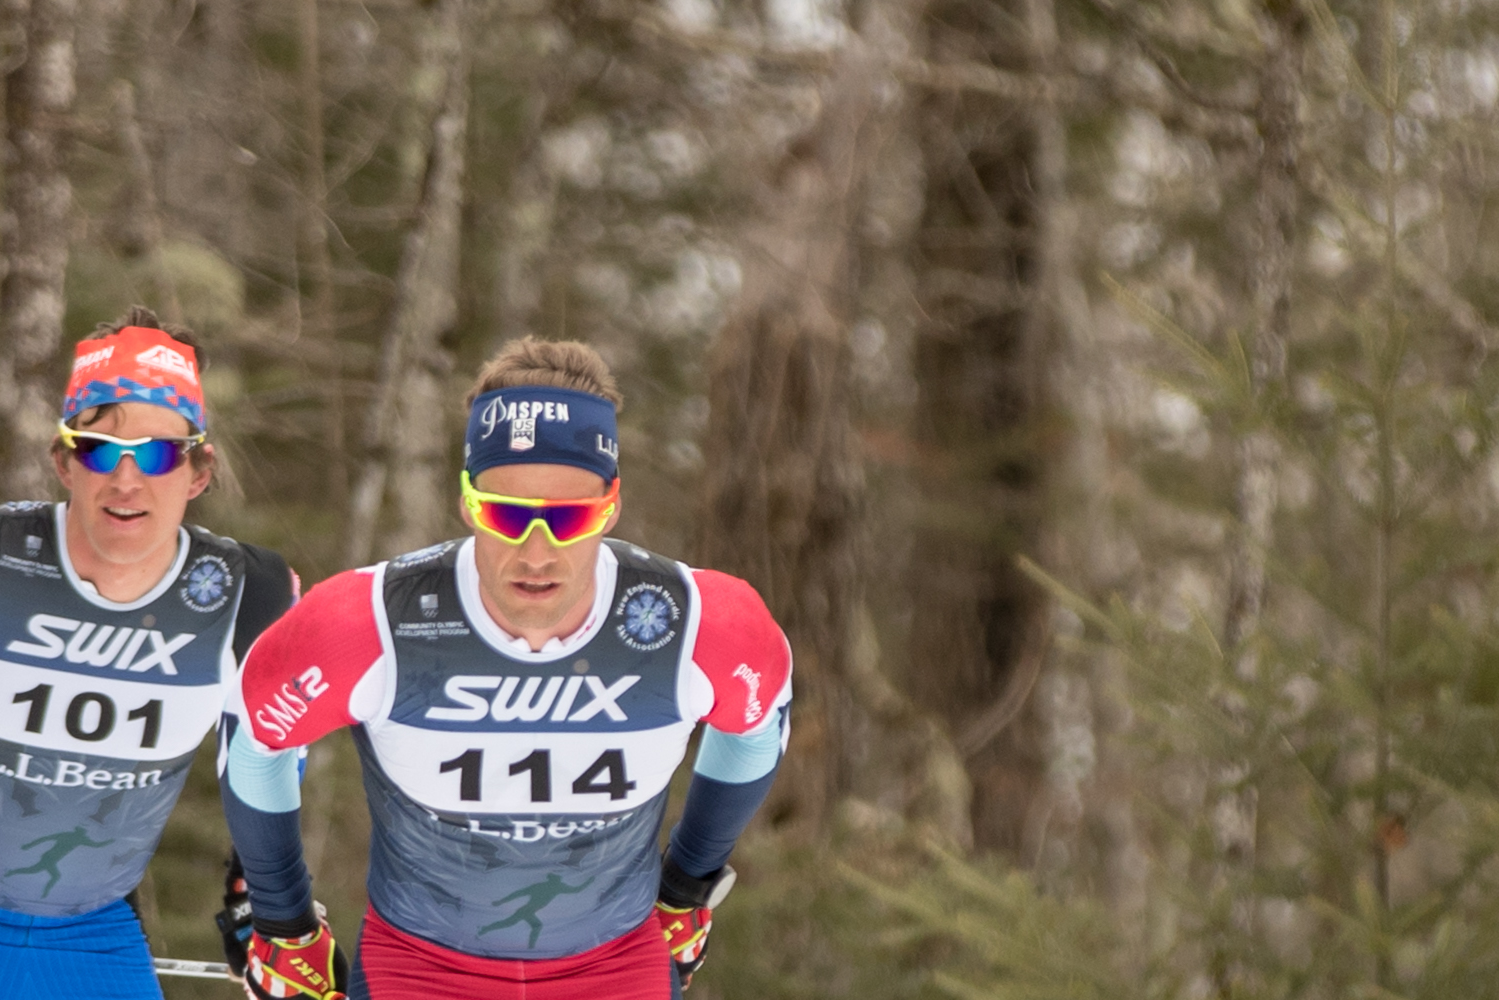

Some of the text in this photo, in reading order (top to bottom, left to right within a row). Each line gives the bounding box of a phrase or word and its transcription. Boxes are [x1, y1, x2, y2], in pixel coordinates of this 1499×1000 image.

[507, 402, 570, 422] ASPEN
[514, 420, 534, 430] US
[616, 582, 681, 620] New England Nordic
[395, 629, 438, 637] DEVELOPMENT
[437, 621, 465, 629] OLYMPIC
[616, 624, 676, 650] Ski Association
[7, 613, 197, 675] SWIX
[12, 683, 164, 749] 101
[425, 675, 641, 722] SWIX
[440, 748, 637, 802] 114
[289, 957, 329, 993] LEKI
